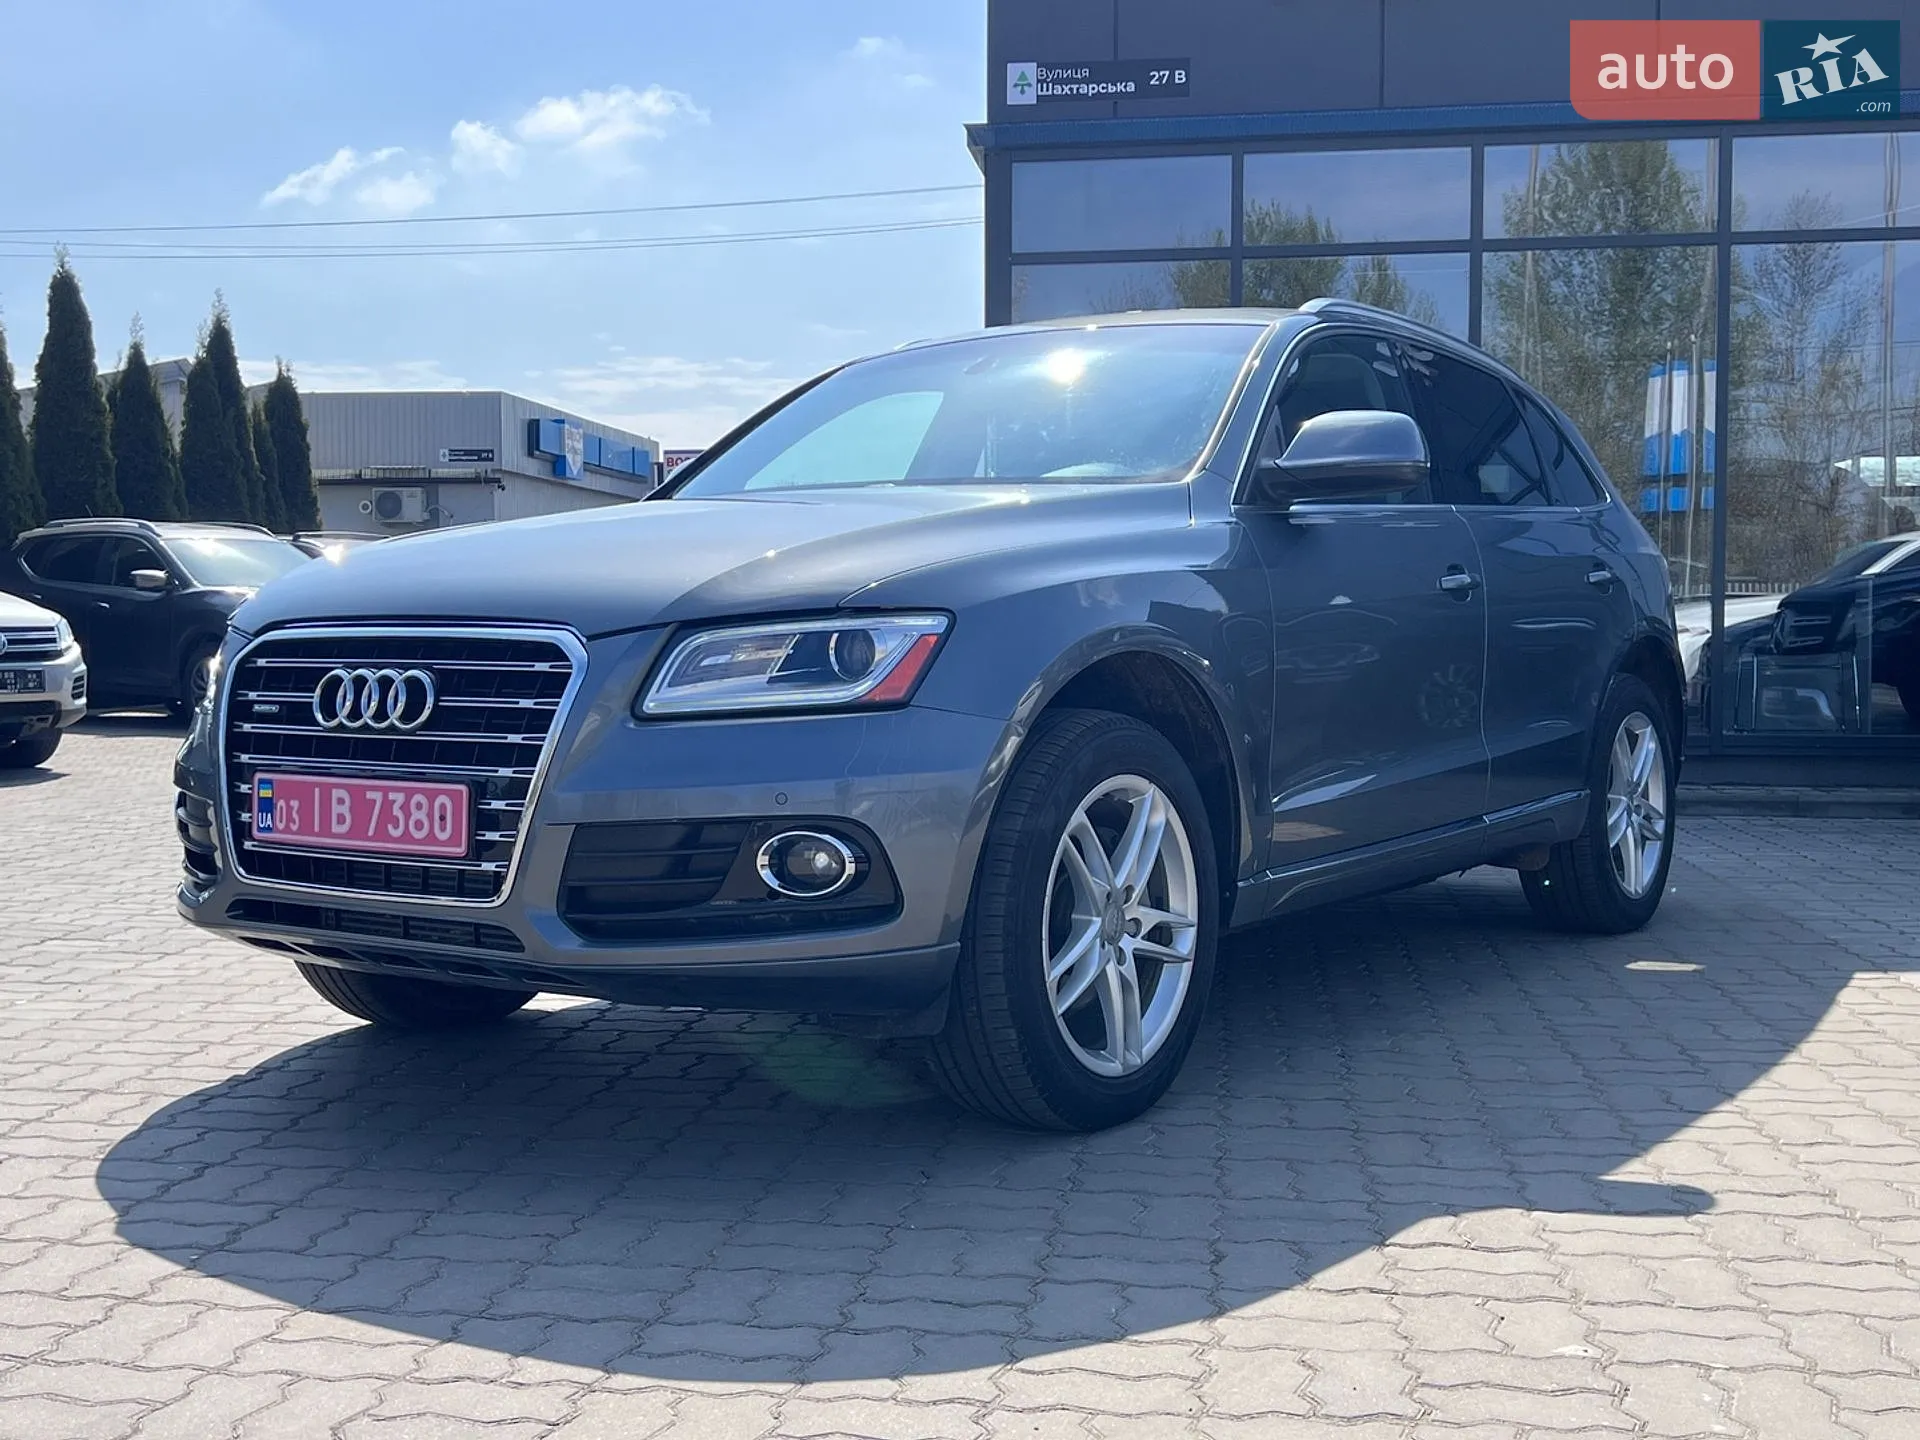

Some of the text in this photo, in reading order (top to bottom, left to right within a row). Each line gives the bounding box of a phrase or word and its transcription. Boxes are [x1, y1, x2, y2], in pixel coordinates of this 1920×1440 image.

[1037, 67, 1089, 81] Вулиця
[1149, 70, 1170, 85] 27
[1037, 80, 1136, 97] Шахтарська
[258, 812, 273, 829] UA
[275, 798, 300, 832] 03
[365, 790, 454, 841] 7380
